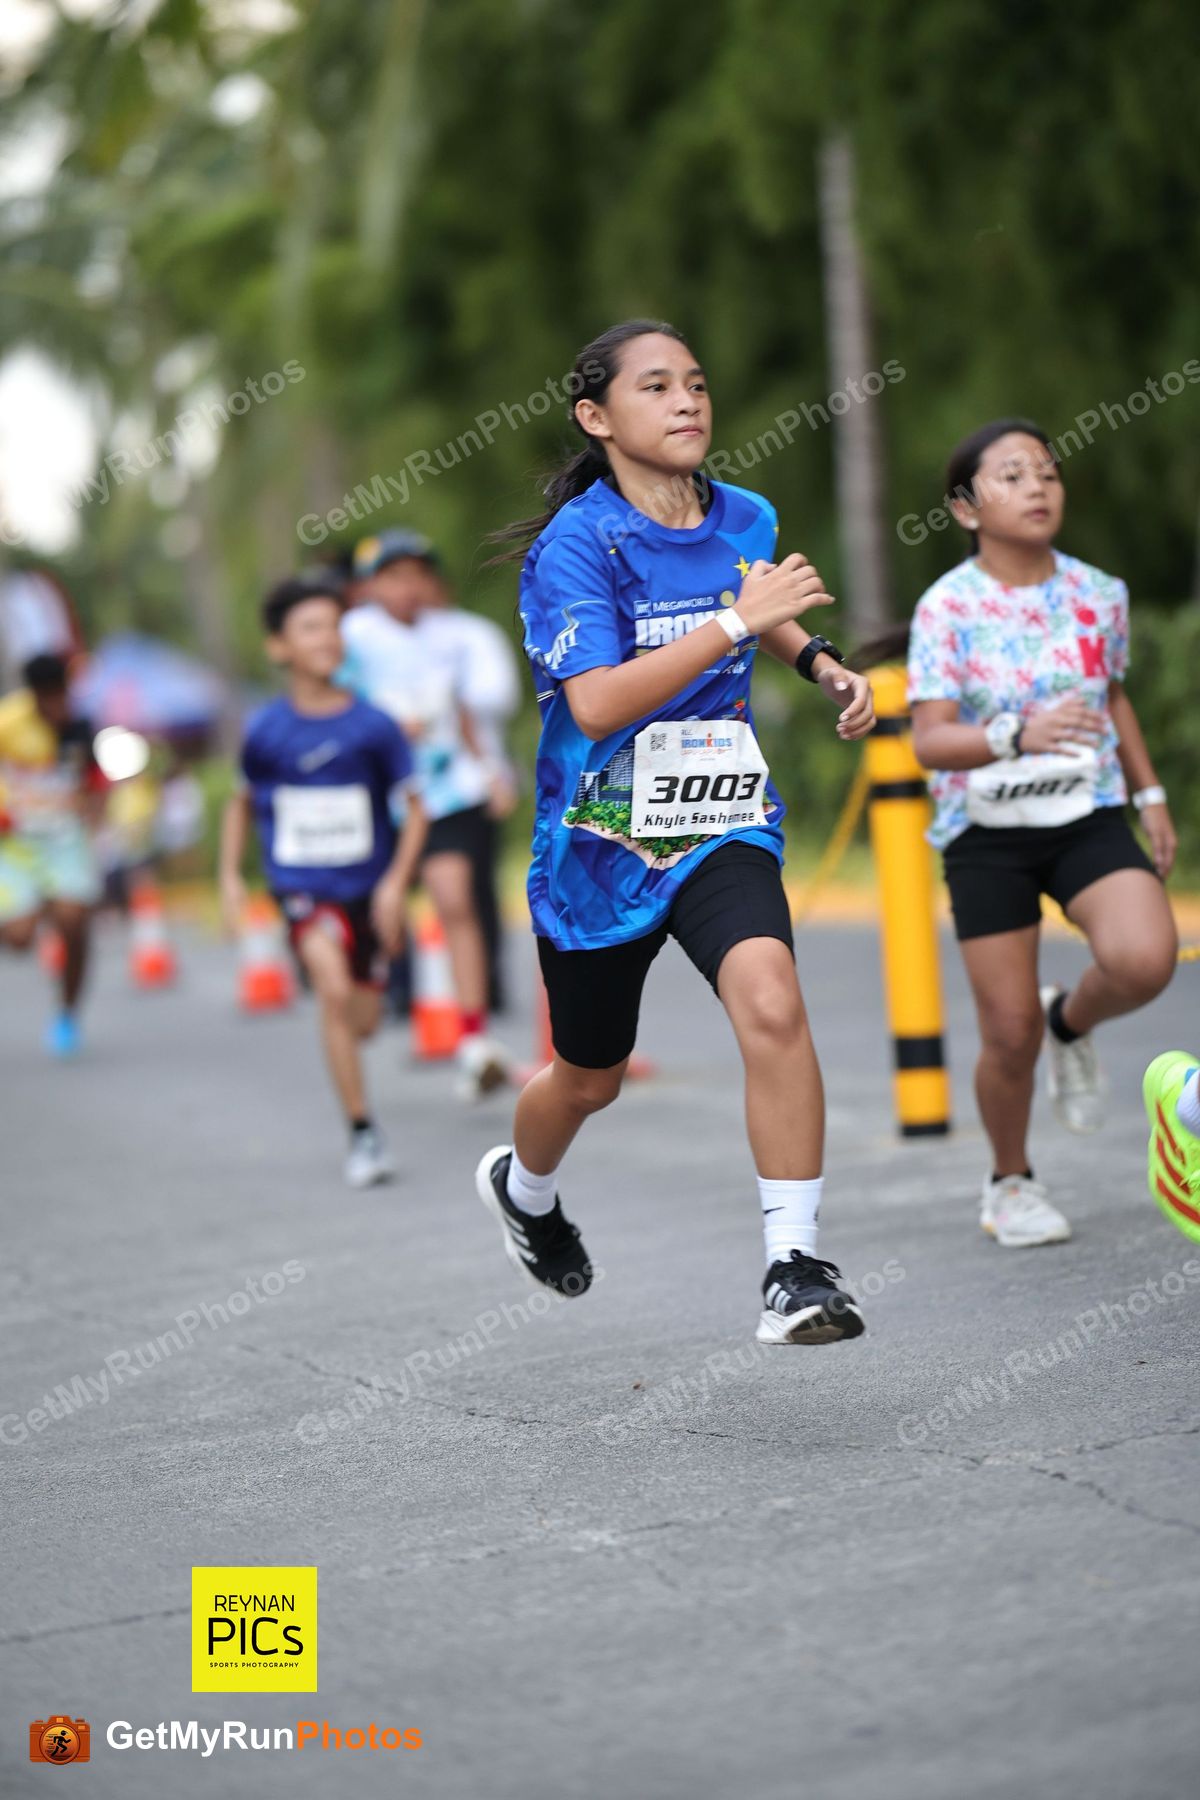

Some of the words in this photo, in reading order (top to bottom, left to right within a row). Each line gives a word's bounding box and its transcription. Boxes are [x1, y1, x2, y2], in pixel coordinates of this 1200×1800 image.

[653, 596, 715, 613] MEGAWORLD
[648, 773, 761, 803] 3003
[644, 814, 687, 828] Khyle
